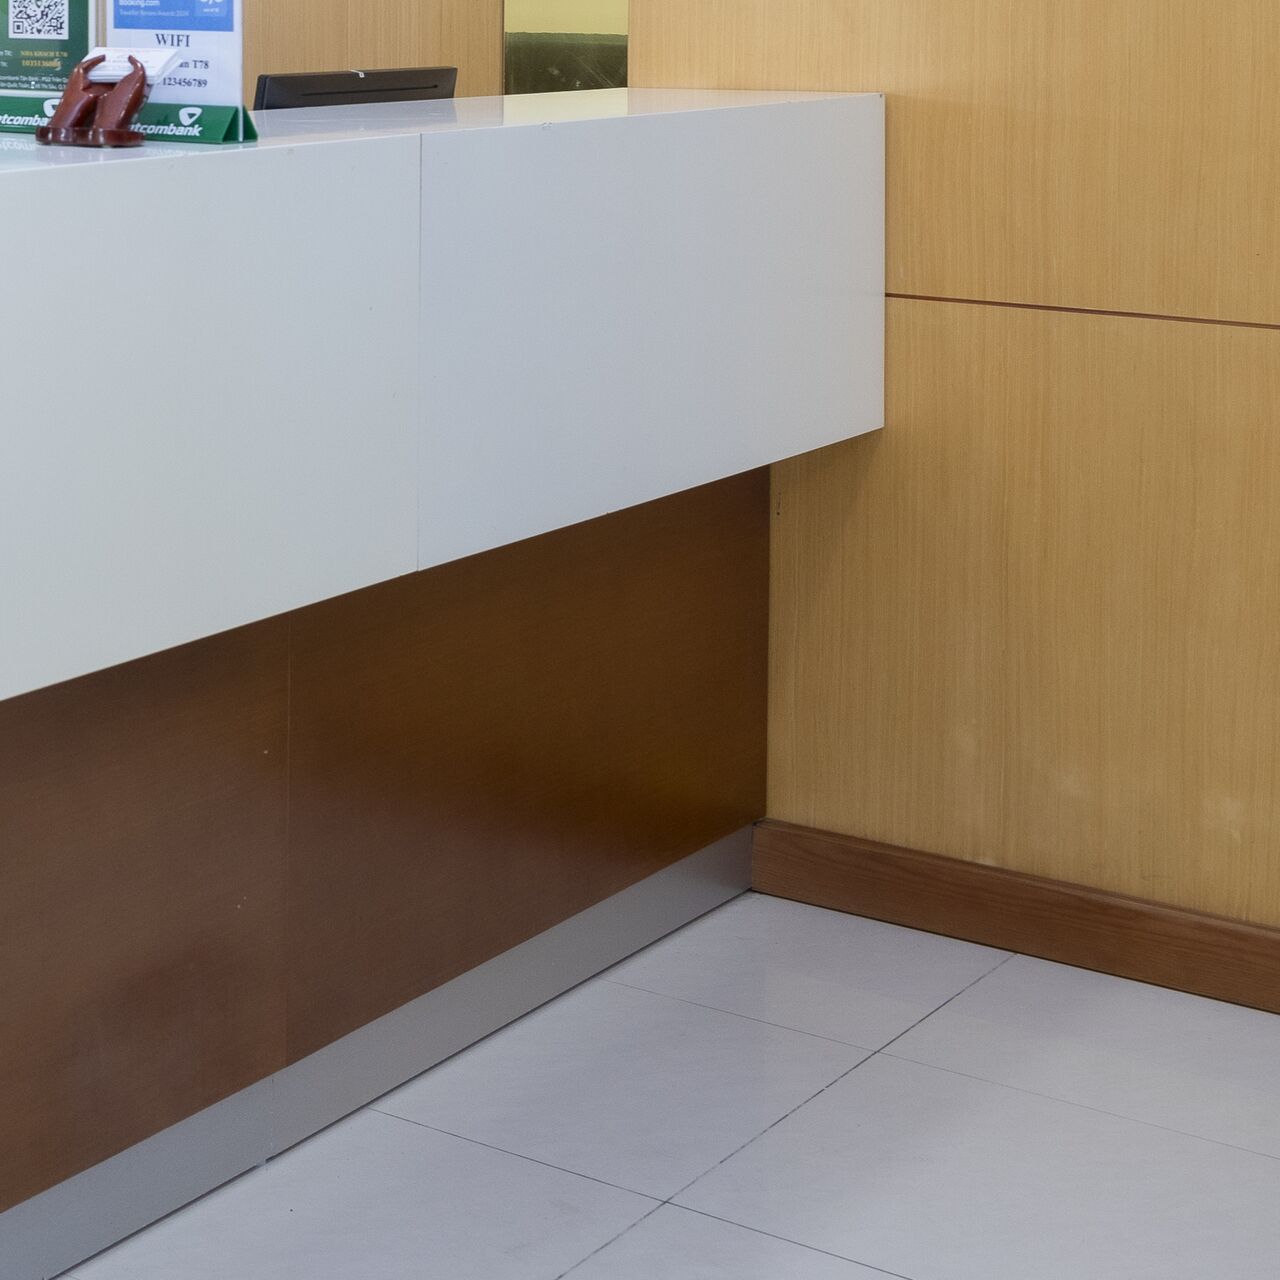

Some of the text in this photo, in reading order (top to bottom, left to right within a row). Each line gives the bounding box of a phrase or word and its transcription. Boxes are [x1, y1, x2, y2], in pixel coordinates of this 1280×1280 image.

[156, 34, 190, 47] WIFI
[192, 60, 209, 69] T78
[163, 77, 208, 87] 123456789
[130, 124, 203, 136] tcombank
